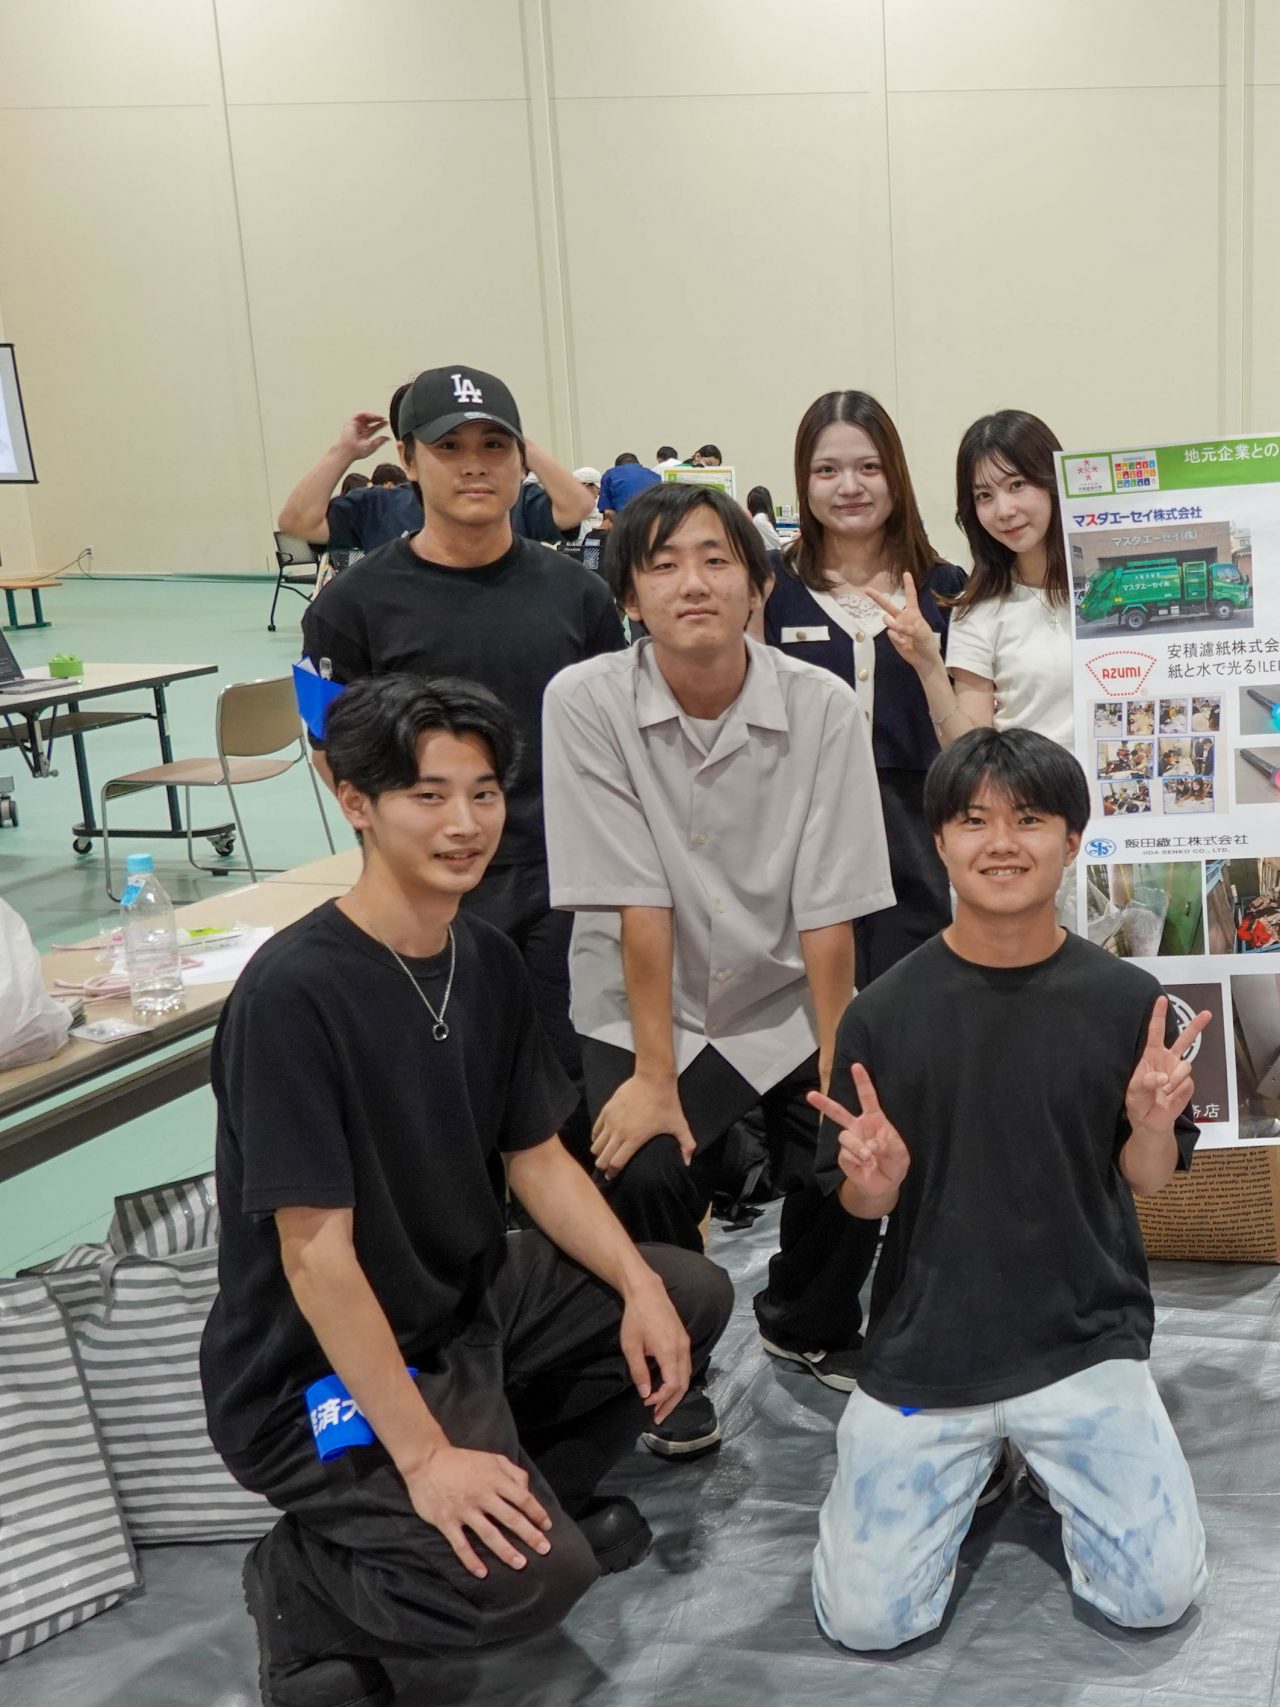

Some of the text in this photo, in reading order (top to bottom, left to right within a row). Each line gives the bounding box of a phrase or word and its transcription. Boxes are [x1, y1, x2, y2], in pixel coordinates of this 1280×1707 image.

[450, 373, 484, 404] LA
[1072, 506, 1203, 527] マスダエーセイ株式会社
[1102, 665, 1142, 680] AZUMI
